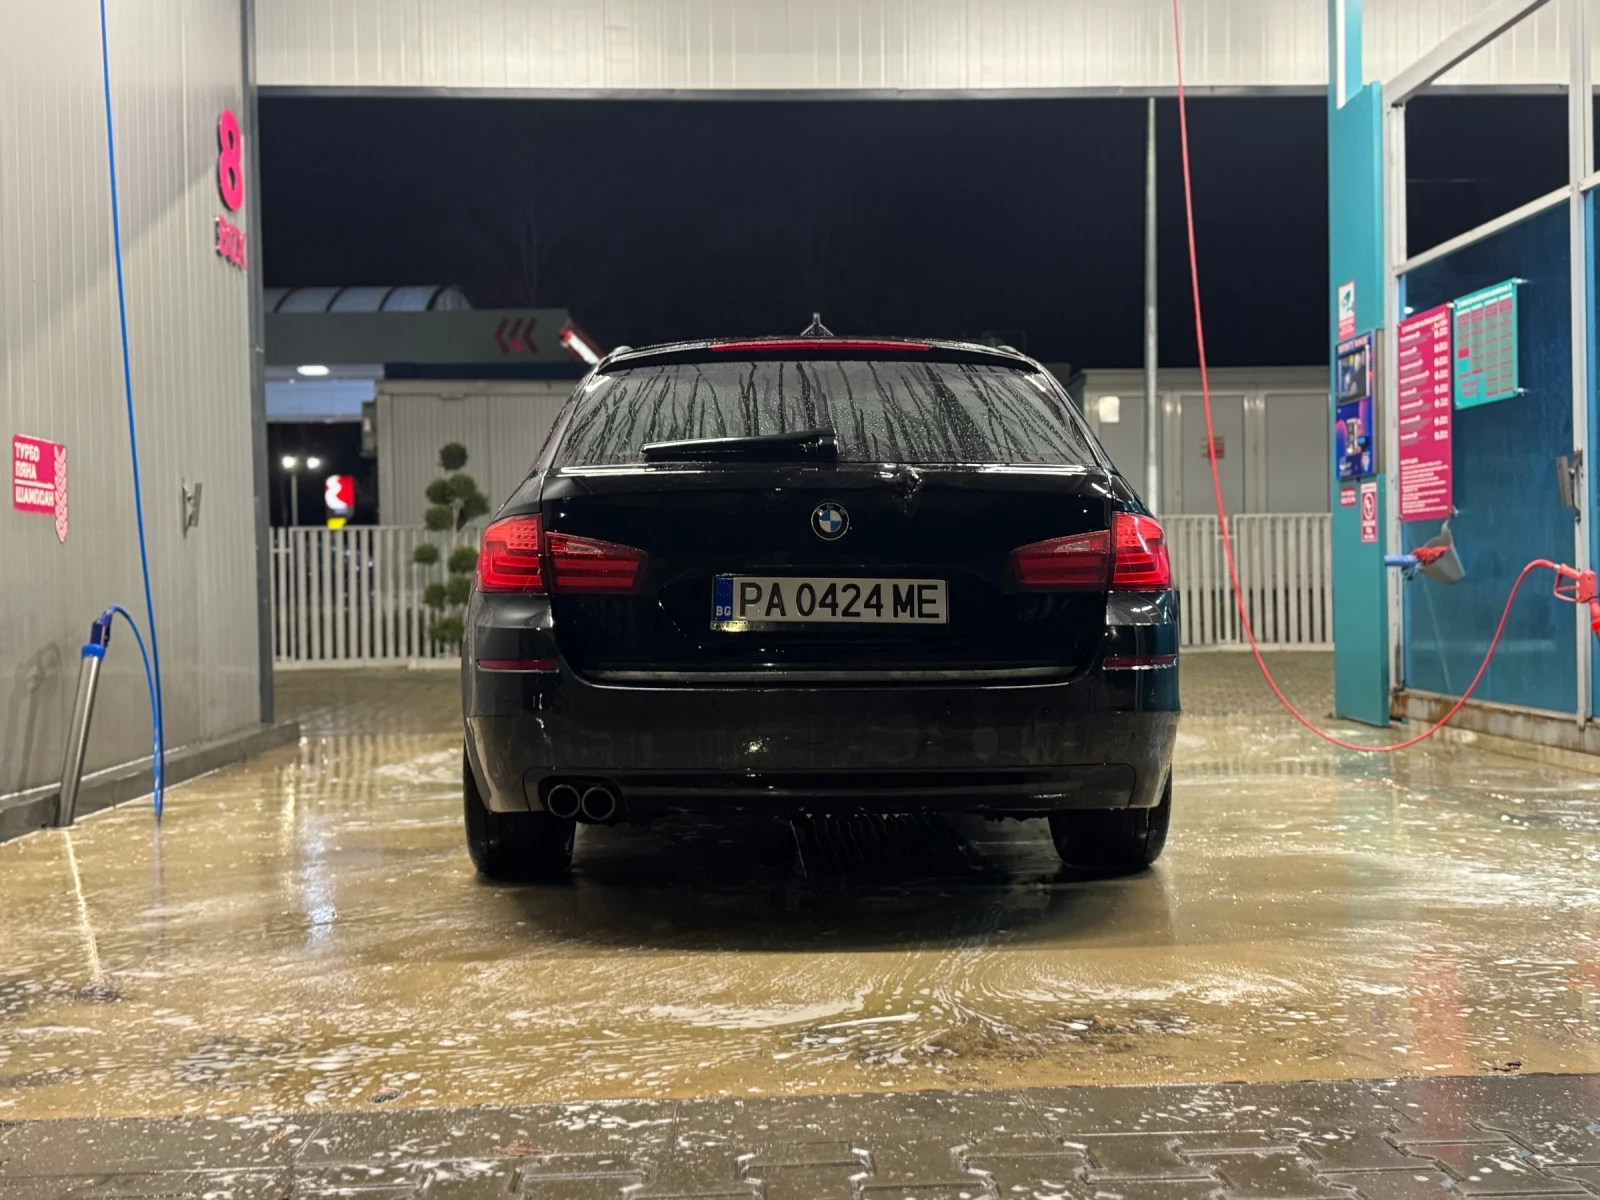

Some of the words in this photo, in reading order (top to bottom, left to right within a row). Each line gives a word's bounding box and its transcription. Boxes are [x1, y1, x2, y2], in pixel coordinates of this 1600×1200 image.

[218, 109, 243, 211] 8
[15, 442, 40, 462] ТУРБО
[15, 461, 37, 479] ПЯНА
[739, 582, 786, 617] PA
[796, 583, 883, 617] 0424
[893, 584, 939, 618] ME
[716, 605, 731, 617] BG
